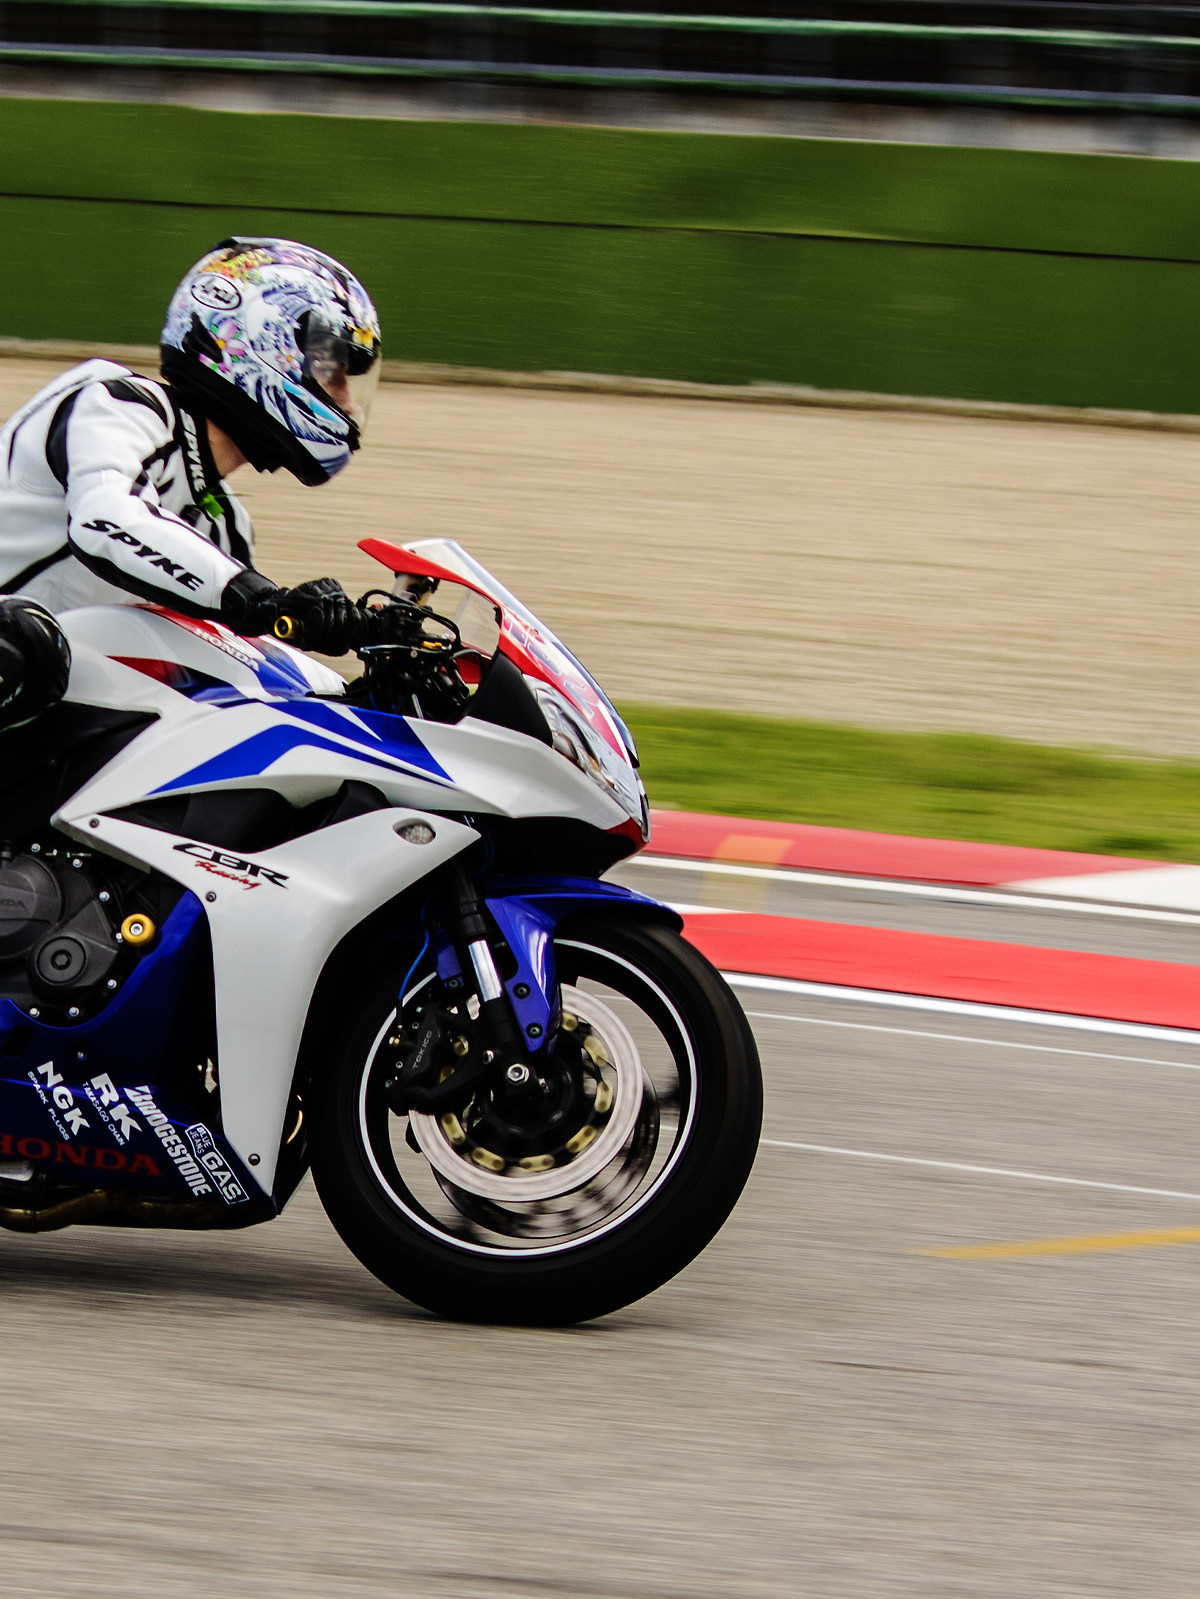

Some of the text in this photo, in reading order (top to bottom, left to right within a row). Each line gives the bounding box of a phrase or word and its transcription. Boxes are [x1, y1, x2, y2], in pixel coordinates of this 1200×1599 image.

[179, 408, 207, 493] SPYKE
[81, 519, 205, 592] SPYKE
[195, 627, 260, 672] HONDA
[172, 843, 290, 889] CBR
[412, 1030, 433, 1069] TOKICO
[27, 1071, 70, 1140] SPARK PLUGS
[37, 1060, 90, 1136] NGK
[82, 1081, 126, 1146] TAKASAGO CHAIN
[90, 1072, 143, 1141] RK
[123, 1085, 212, 1197] BRIDGESTONE
[189, 1130, 205, 1154] JEANS
[196, 1126, 212, 1149] BLUE
[201, 1151, 242, 1201] GAS
